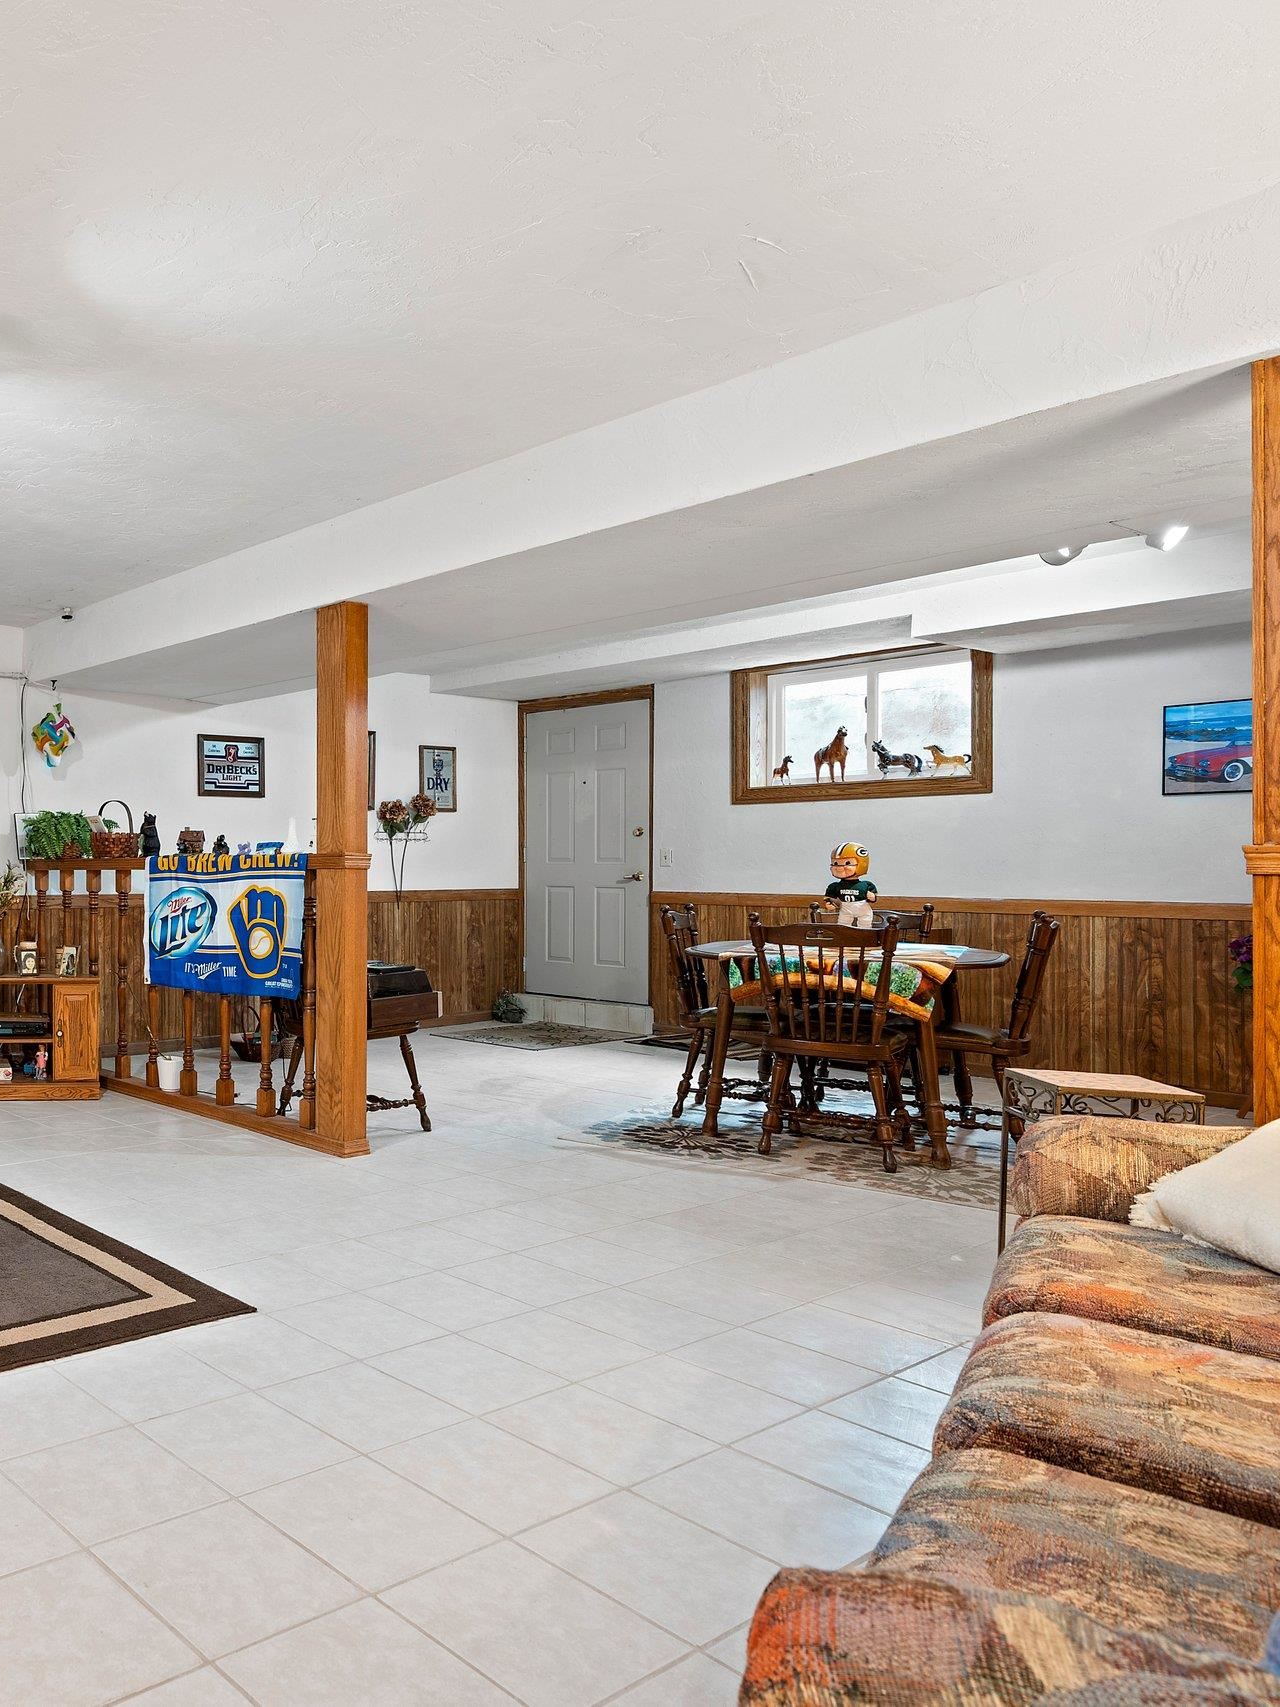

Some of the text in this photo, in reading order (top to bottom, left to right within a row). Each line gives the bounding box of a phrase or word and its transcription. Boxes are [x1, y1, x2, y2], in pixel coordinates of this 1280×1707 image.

[427, 776, 450, 793] DRY
[157, 853, 299, 873] GO BREW CREW!
[167, 897, 192, 913] Miller
[159, 902, 207, 952] Lite
[195, 961, 222, 980] Miller
[222, 966, 237, 977] TIME
